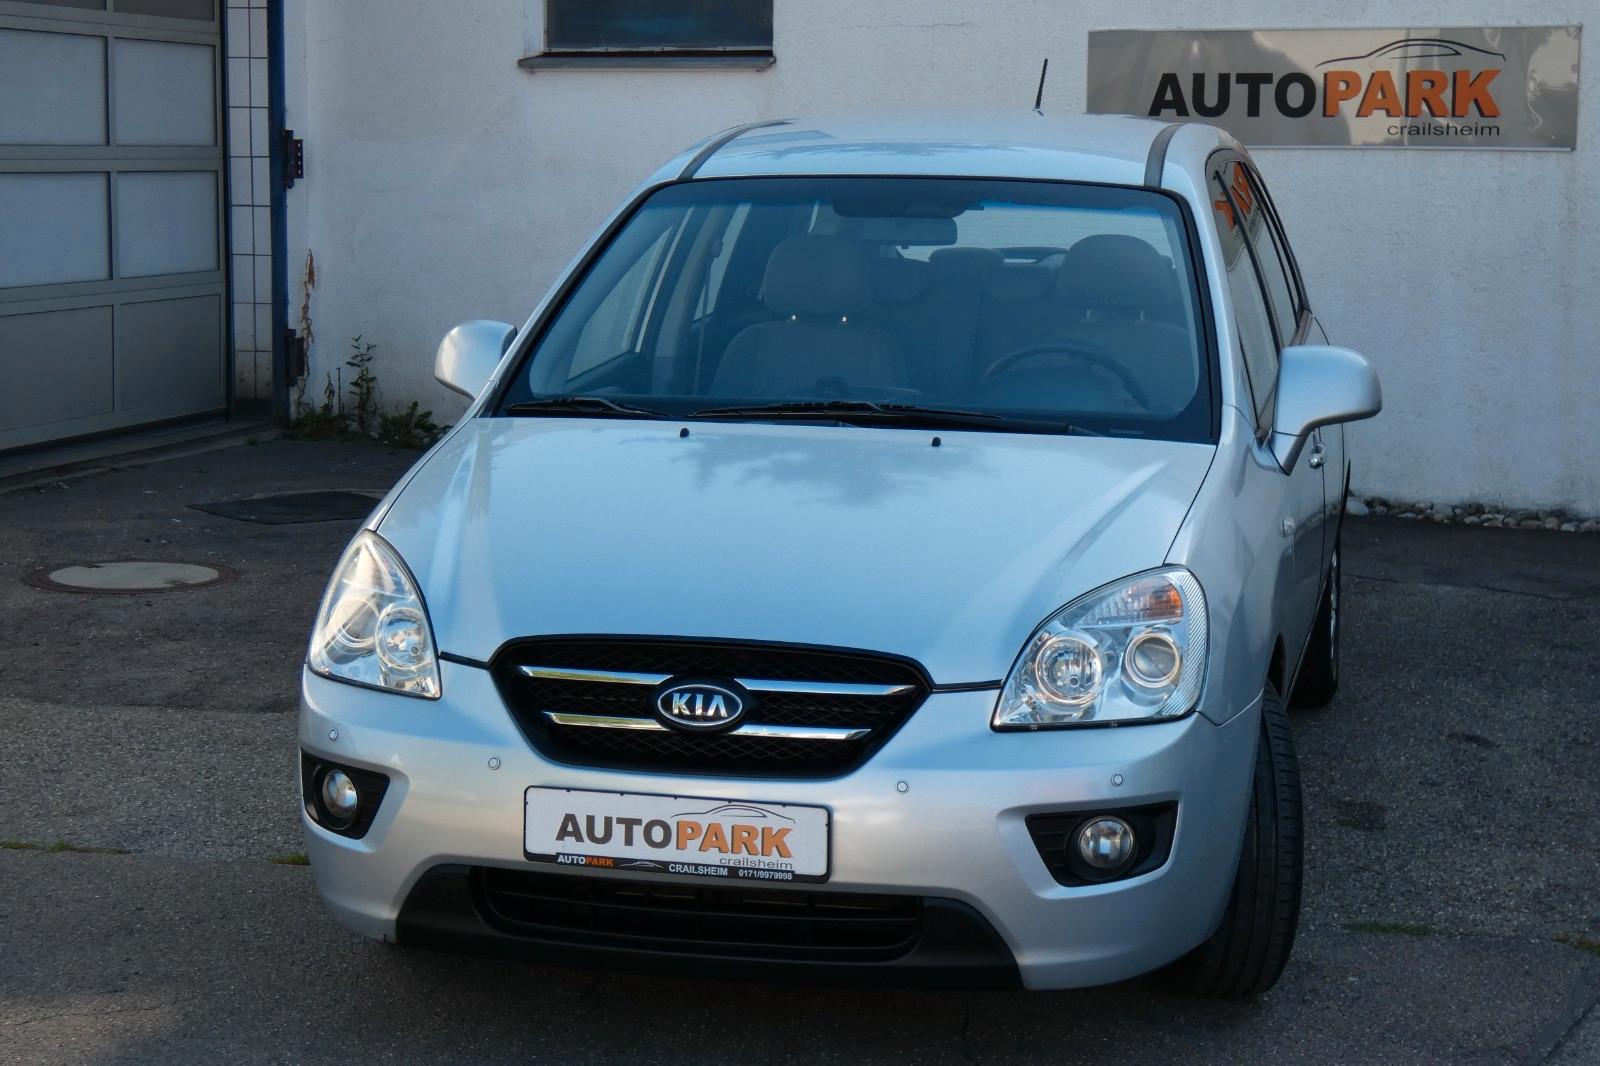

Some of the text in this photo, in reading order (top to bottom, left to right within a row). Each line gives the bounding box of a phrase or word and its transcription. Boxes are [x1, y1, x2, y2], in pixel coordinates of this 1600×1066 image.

[1147, 68, 1502, 118] AUTOPARK
[1386, 121, 1501, 137] crailsheim
[672, 692, 728, 718] KIA
[555, 812, 793, 858] AUTOPARK
[668, 863, 728, 876] CRAILSHEIM
[719, 856, 793, 870] crailsheim
